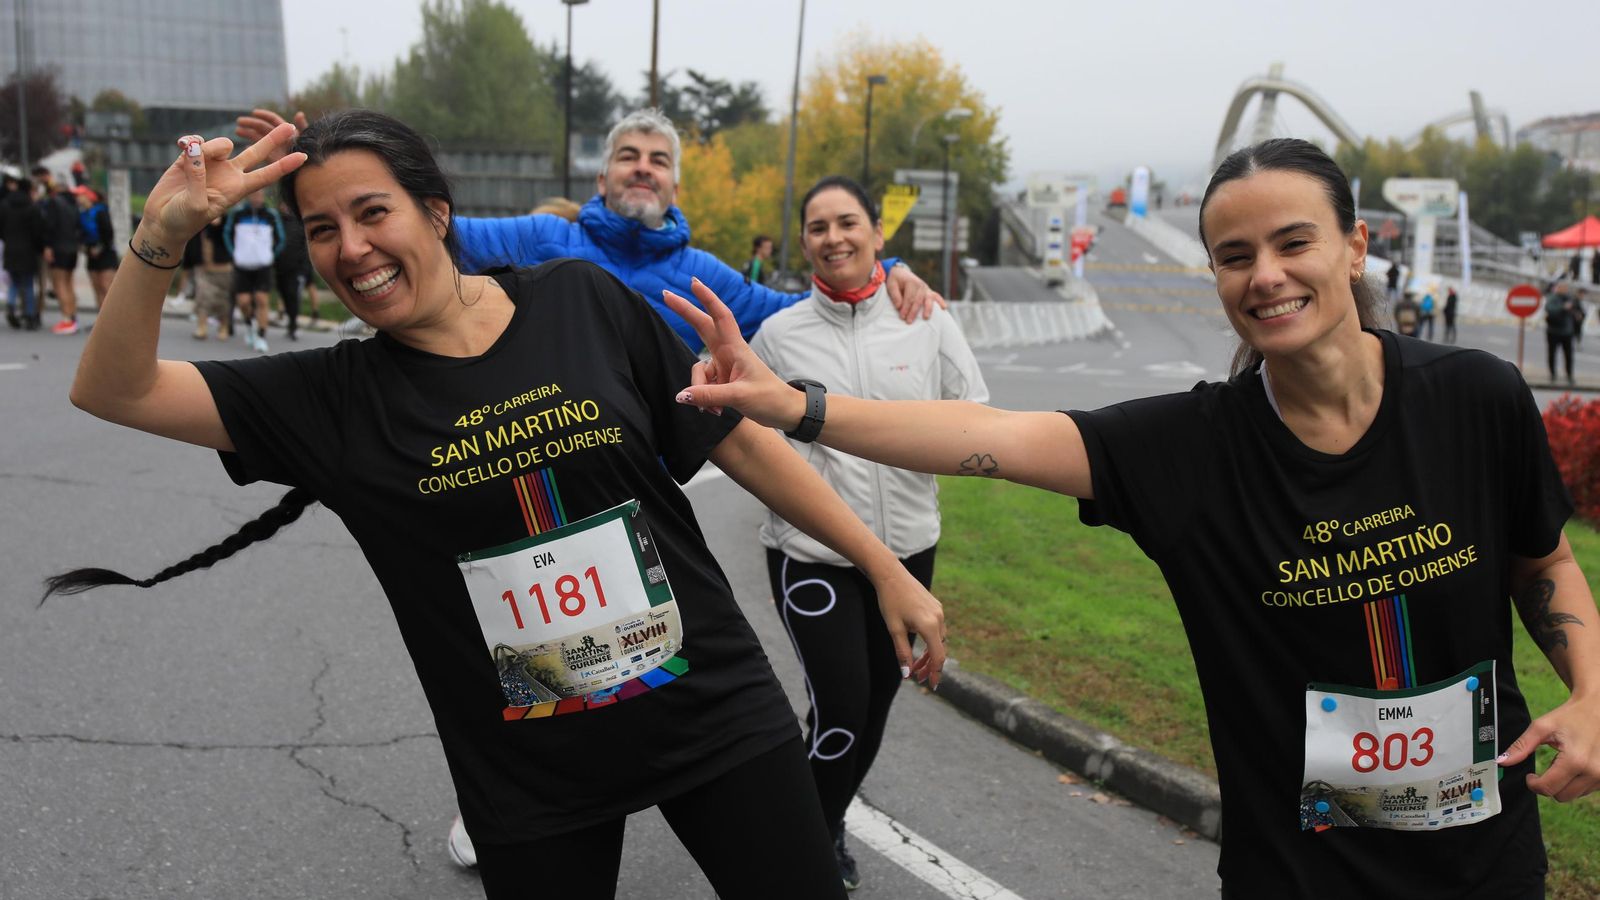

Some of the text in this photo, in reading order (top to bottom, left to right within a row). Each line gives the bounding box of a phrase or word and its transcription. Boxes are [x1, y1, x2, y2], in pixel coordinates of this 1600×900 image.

[454, 384, 562, 428] 48º CARREIRA
[431, 399, 600, 467] SAN MARTIÑO
[418, 428, 623, 494] CONCELLO DE OURENSE
[1303, 505, 1415, 544] 48º CARREIRA
[533, 552, 556, 569] EVA
[1279, 522, 1452, 583] SAN MARTIÑO
[1262, 545, 1478, 607] CONCELLO DE OURENSE
[502, 566, 607, 629] 1181
[566, 646, 584, 656] SAN
[621, 622, 667, 648] XLVIII
[570, 654, 612, 670] OURENSE
[591, 664, 616, 676] CaixaBank
[1379, 706, 1413, 720] EMMA
[1352, 727, 1434, 773] 803
